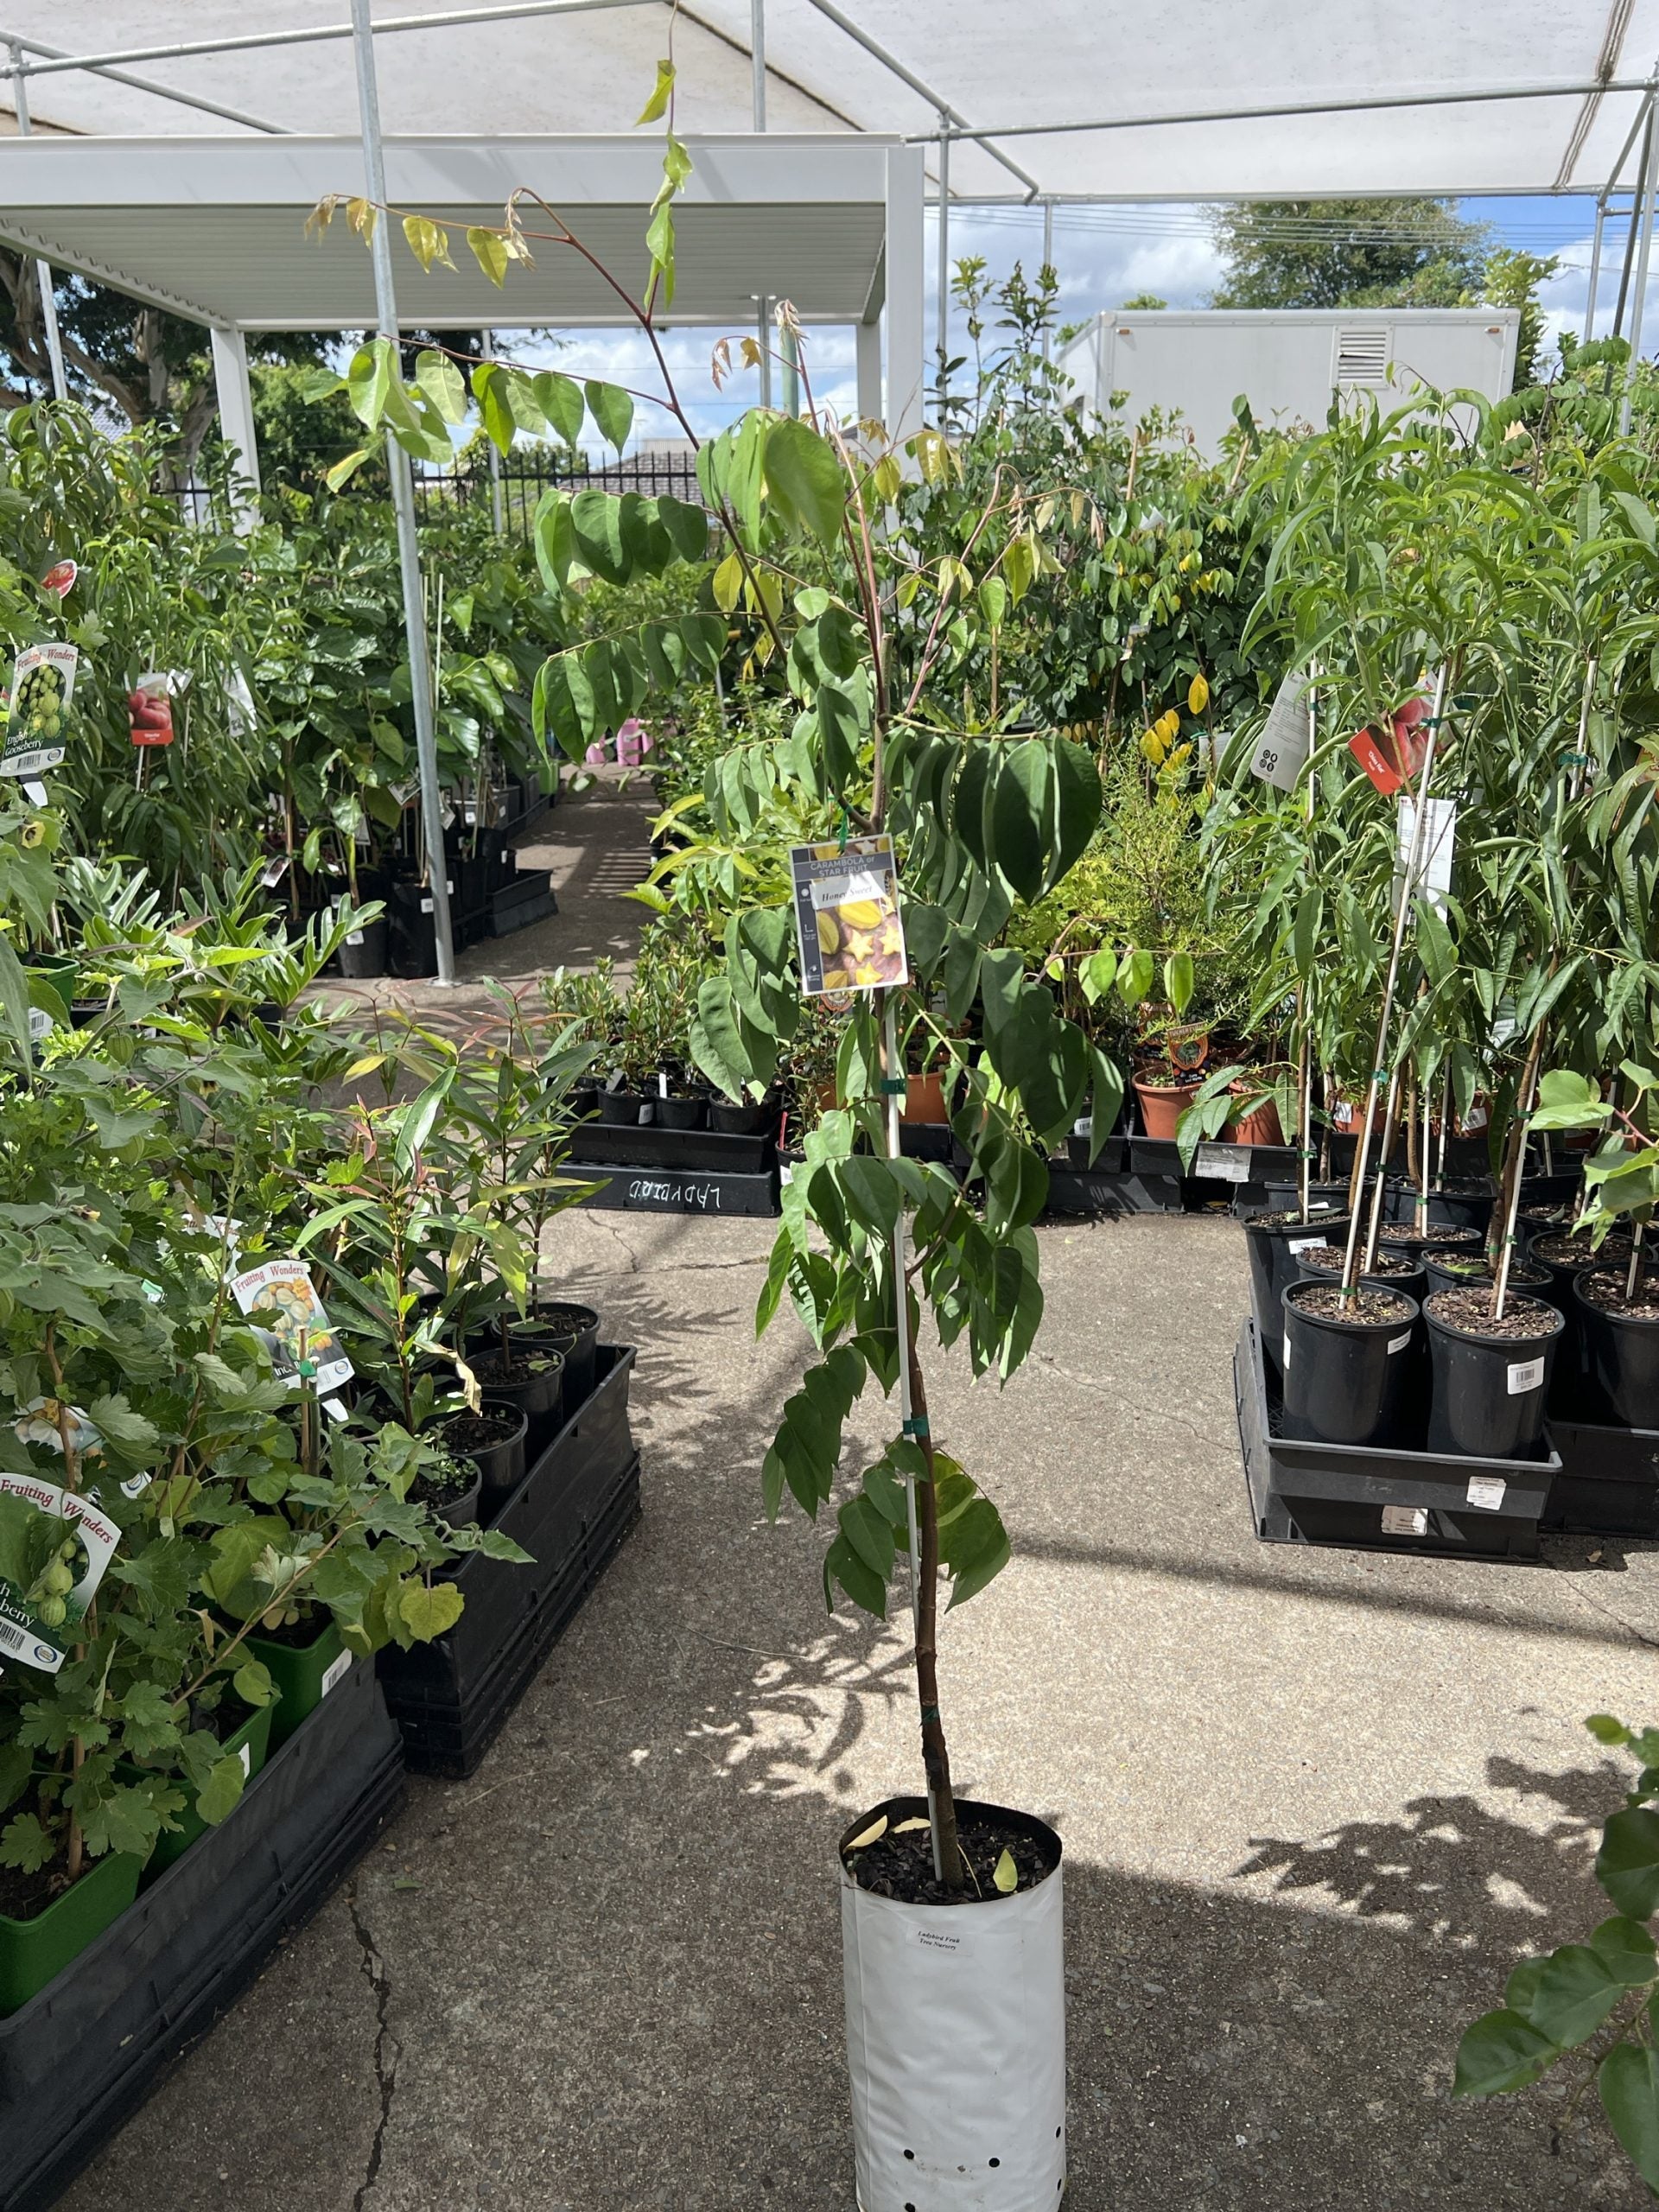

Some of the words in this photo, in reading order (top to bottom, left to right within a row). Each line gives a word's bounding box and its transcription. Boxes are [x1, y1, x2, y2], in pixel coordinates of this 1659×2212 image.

[16, 652, 42, 671] Fruiting
[47, 648, 76, 663] Wonders
[7, 732, 29, 745] English
[5, 740, 44, 757] Gooseberry
[810, 857, 864, 871] CARAMBOLA
[819, 868, 841, 877] STAR
[842, 864, 868, 874] FRUIT
[822, 889, 848, 902] Honey
[849, 884, 874, 897] Sweet
[629, 1180, 721, 1209] LADYBIRD
[235, 1271, 266, 1293] Fruiting
[270, 1264, 304, 1277] Wonders
[1, 1478, 54, 1507] Fruiting
[64, 1501, 113, 1543] Wnders
[918, 1930, 944, 1942] Ladybird
[933, 1942, 956, 1950] Nursery
